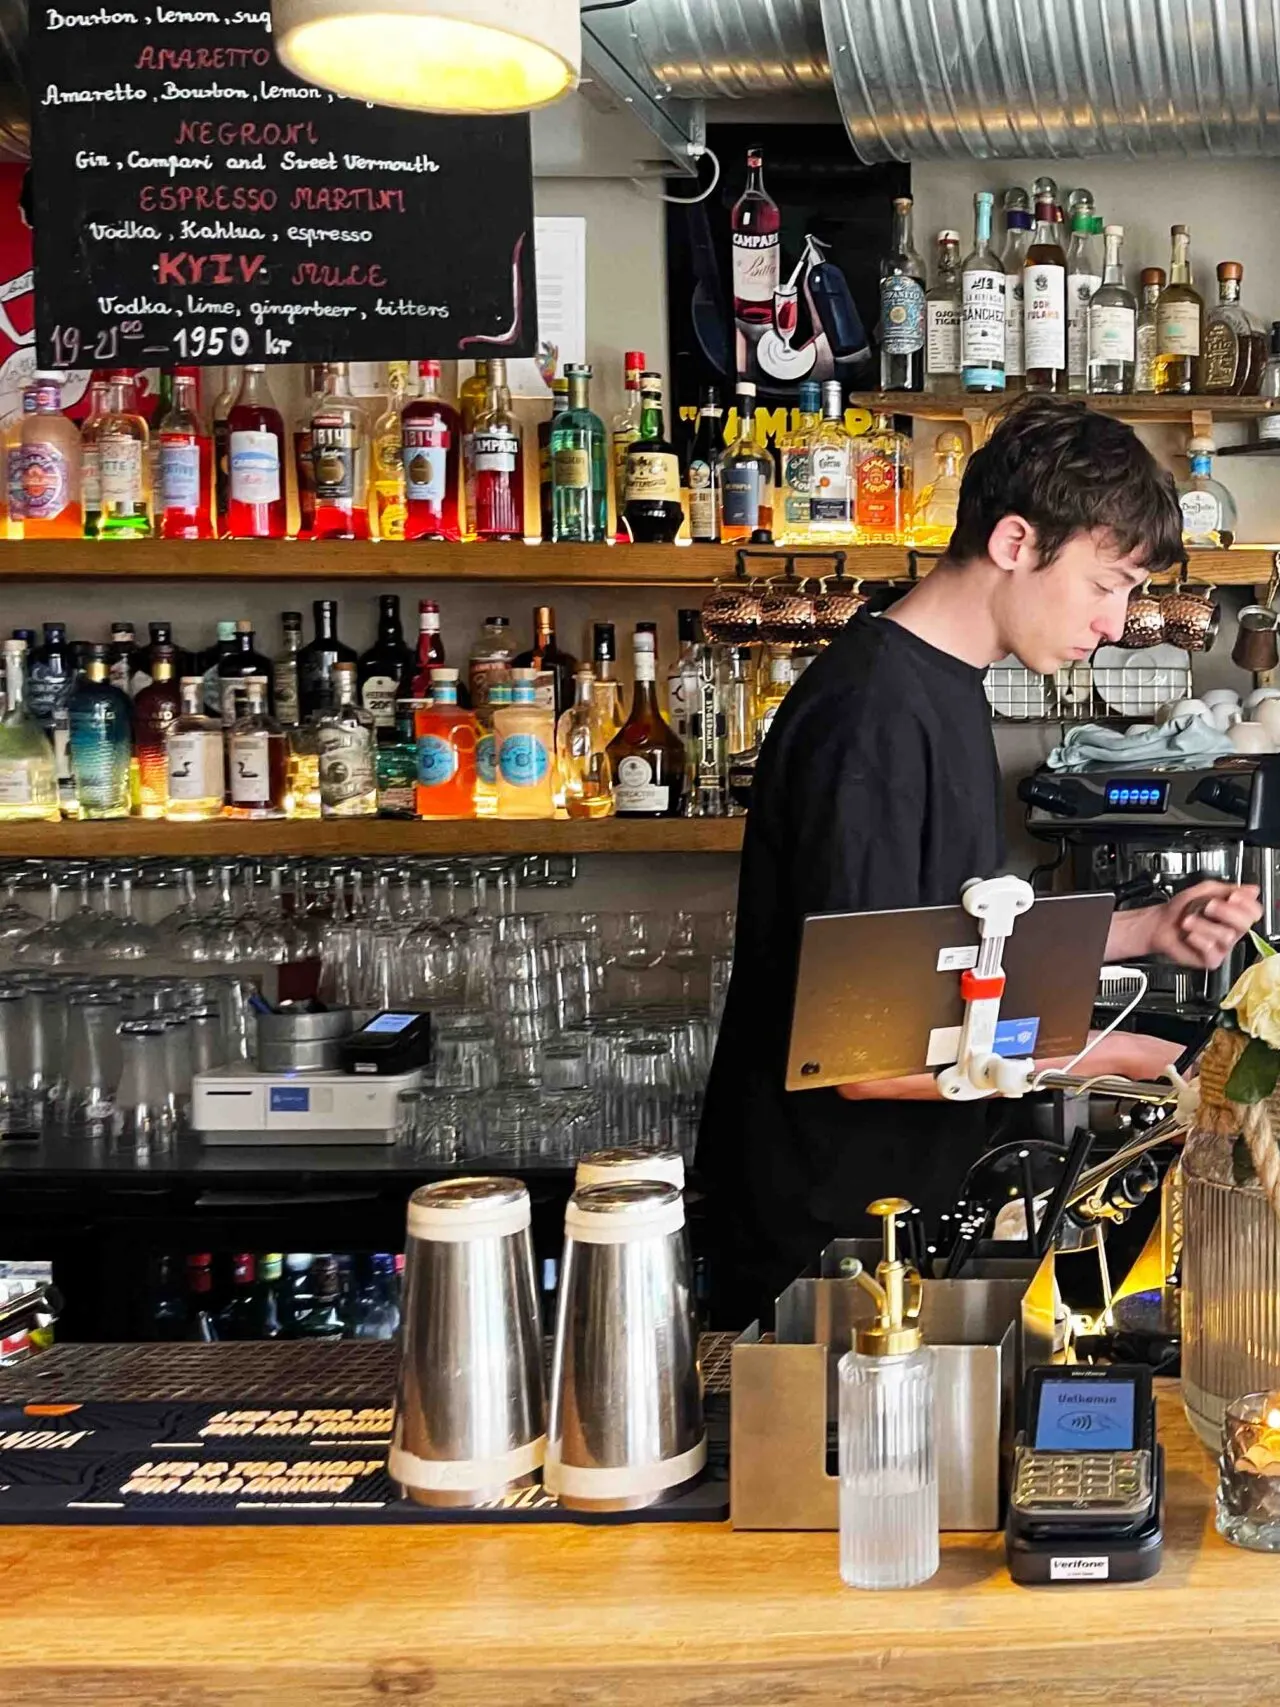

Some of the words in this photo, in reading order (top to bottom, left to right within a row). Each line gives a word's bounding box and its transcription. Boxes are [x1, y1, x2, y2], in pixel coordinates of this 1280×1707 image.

[135, 45, 270, 70] AMARETTO
[175, 119, 319, 145] NEGRONI
[127, 151, 214, 177] Campari
[226, 152, 266, 170] and
[343, 154, 440, 173] Vermouth
[140, 186, 278, 212] ESPRESSO
[290, 187, 406, 213] MARTINI
[287, 225, 373, 248] espresso
[375, 298, 450, 318] bitters
[173, 326, 250, 358] 1950
[265, 329, 293, 355] kr
[1053, 1559, 1105, 1569] Verifone
